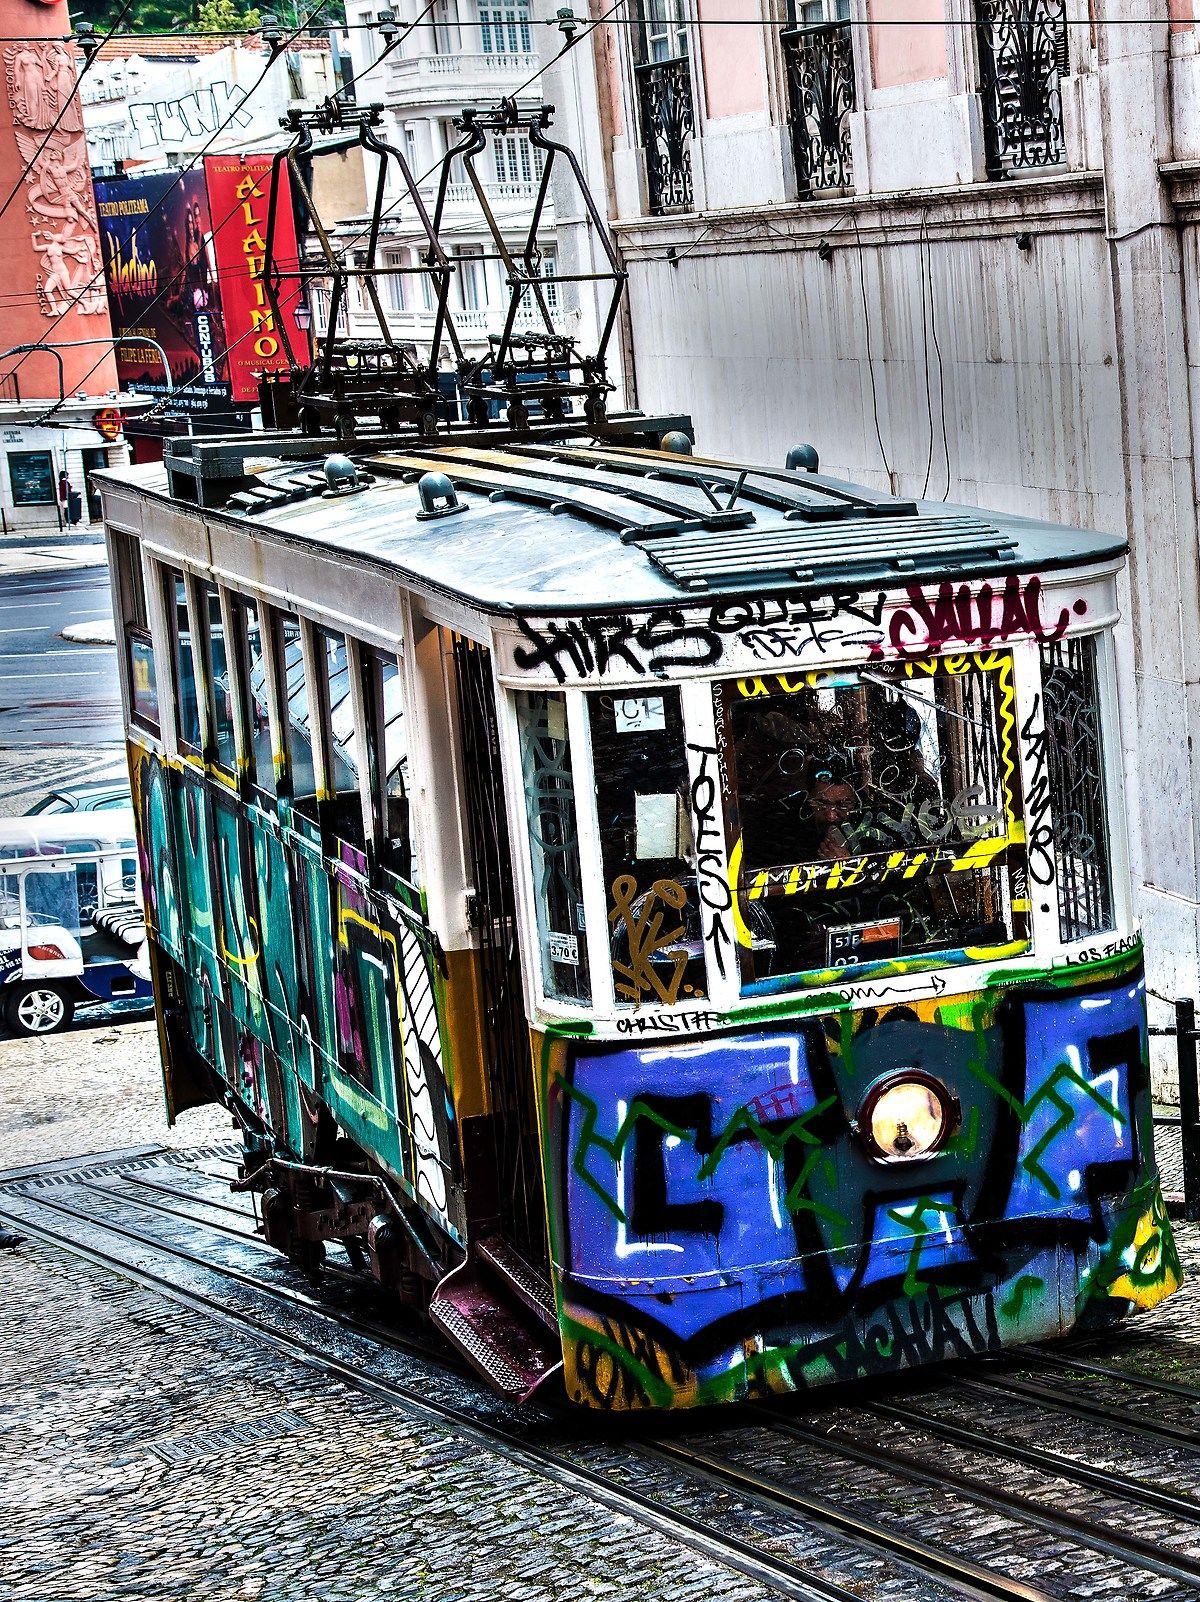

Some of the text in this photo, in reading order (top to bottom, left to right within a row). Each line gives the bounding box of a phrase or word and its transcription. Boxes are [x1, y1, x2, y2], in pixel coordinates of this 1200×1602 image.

[128, 81, 254, 149] FUNK
[213, 165, 240, 173] TEATRO
[236, 175, 278, 357] ALADINO
[551, 945, 578, 960] 3.70 €
